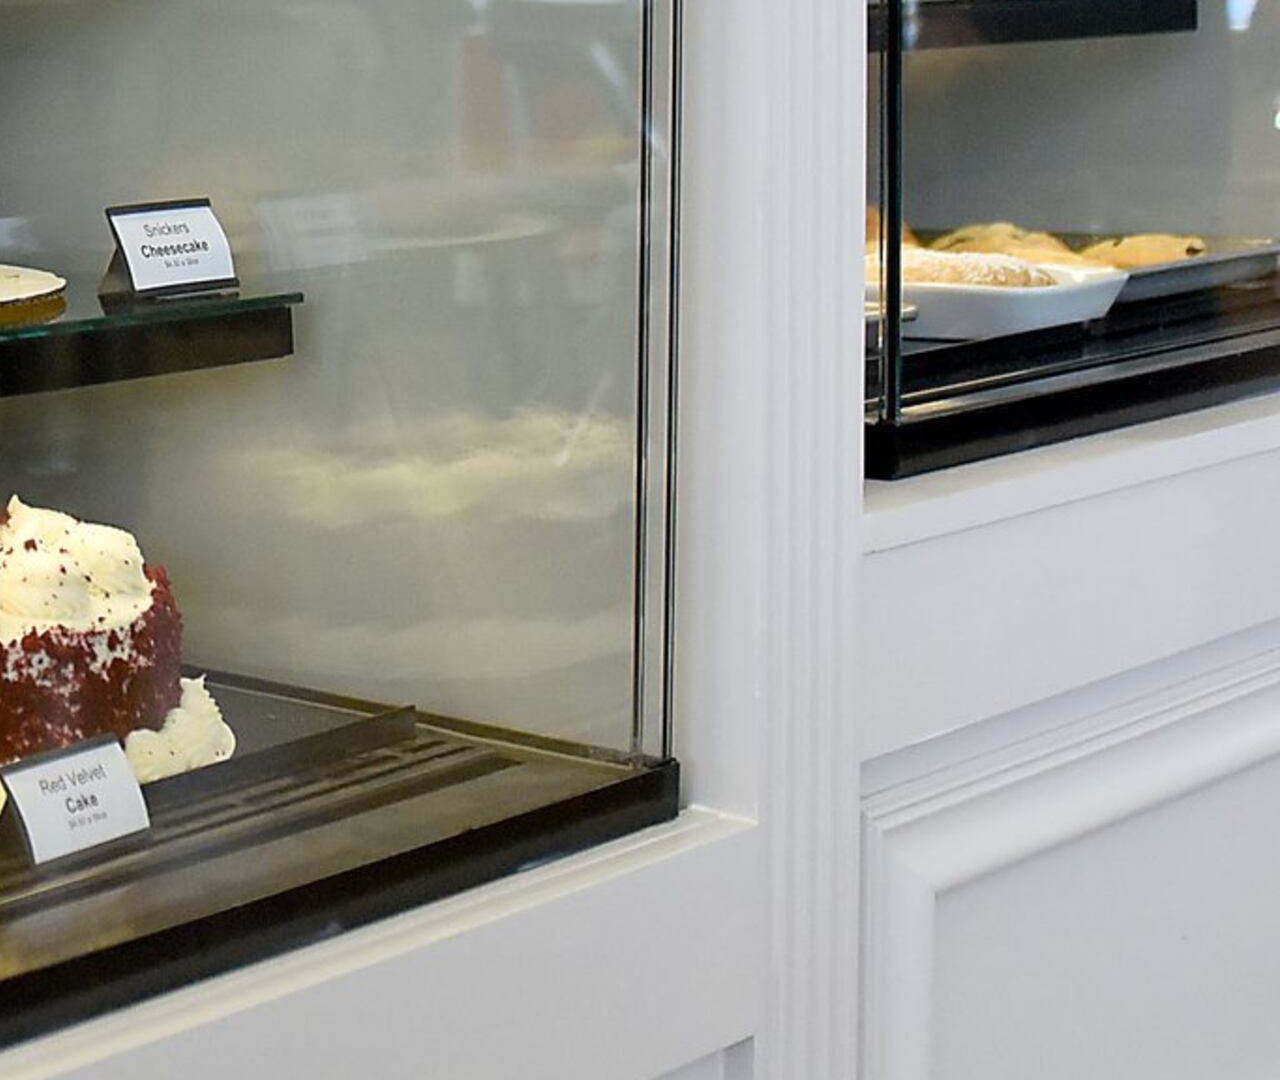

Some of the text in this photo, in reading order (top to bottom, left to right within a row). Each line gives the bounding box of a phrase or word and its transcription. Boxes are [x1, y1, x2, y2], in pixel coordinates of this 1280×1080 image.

[143, 222, 190, 238] Snickers
[140, 239, 209, 259] Cheesecake
[38, 763, 108, 796] Red Velvet
[64, 793, 100, 814] Cake
